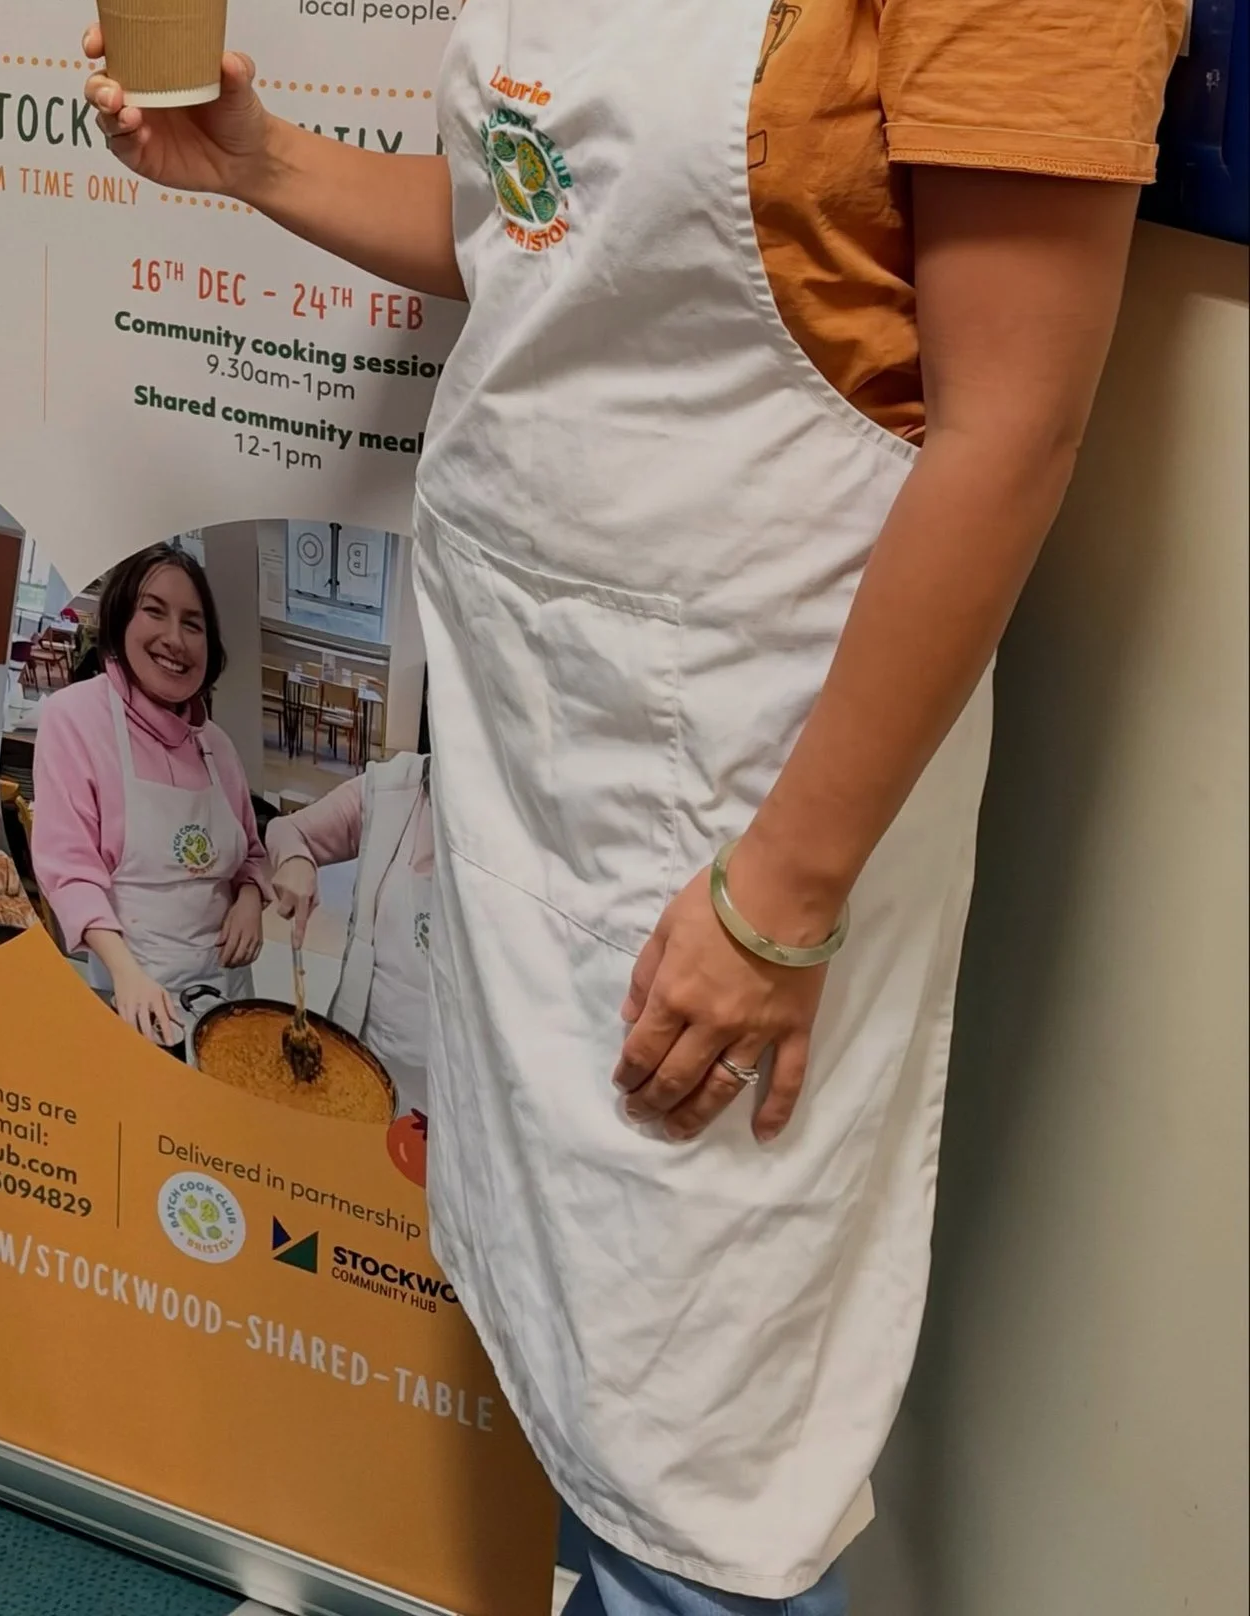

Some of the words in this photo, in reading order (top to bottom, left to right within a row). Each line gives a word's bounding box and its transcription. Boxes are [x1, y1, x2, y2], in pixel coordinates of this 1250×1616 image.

[489, 64, 551, 106] Laurie
[19, 168, 73, 198] TIME
[88, 175, 139, 205] ONLY
[505, 216, 570, 252] BRISTOL
[199, 267, 246, 306] DEC
[370, 293, 424, 330] FEB
[114, 310, 246, 356] Community
[251, 338, 347, 376] cooking
[207, 354, 355, 401] 9.30am-1pm
[134, 385, 216, 418] Shared
[221, 406, 354, 451] community
[234, 433, 321, 470] 12-1pm
[38, 1100, 77, 1124] are
[158, 1135, 262, 1183] Delivered
[267, 1168, 284, 1191] in
[291, 1182, 421, 1241] partnership
[167, 1188, 181, 1228] BATCH
[179, 1181, 214, 1194] COOK
[215, 1193, 237, 1224] CLUB
[187, 1237, 233, 1253] BRISTOL
[331, 1266, 407, 1303] COMMUNITY
[410, 1293, 437, 1313] HUB
[333, 1246, 458, 1303] STOCKWO
